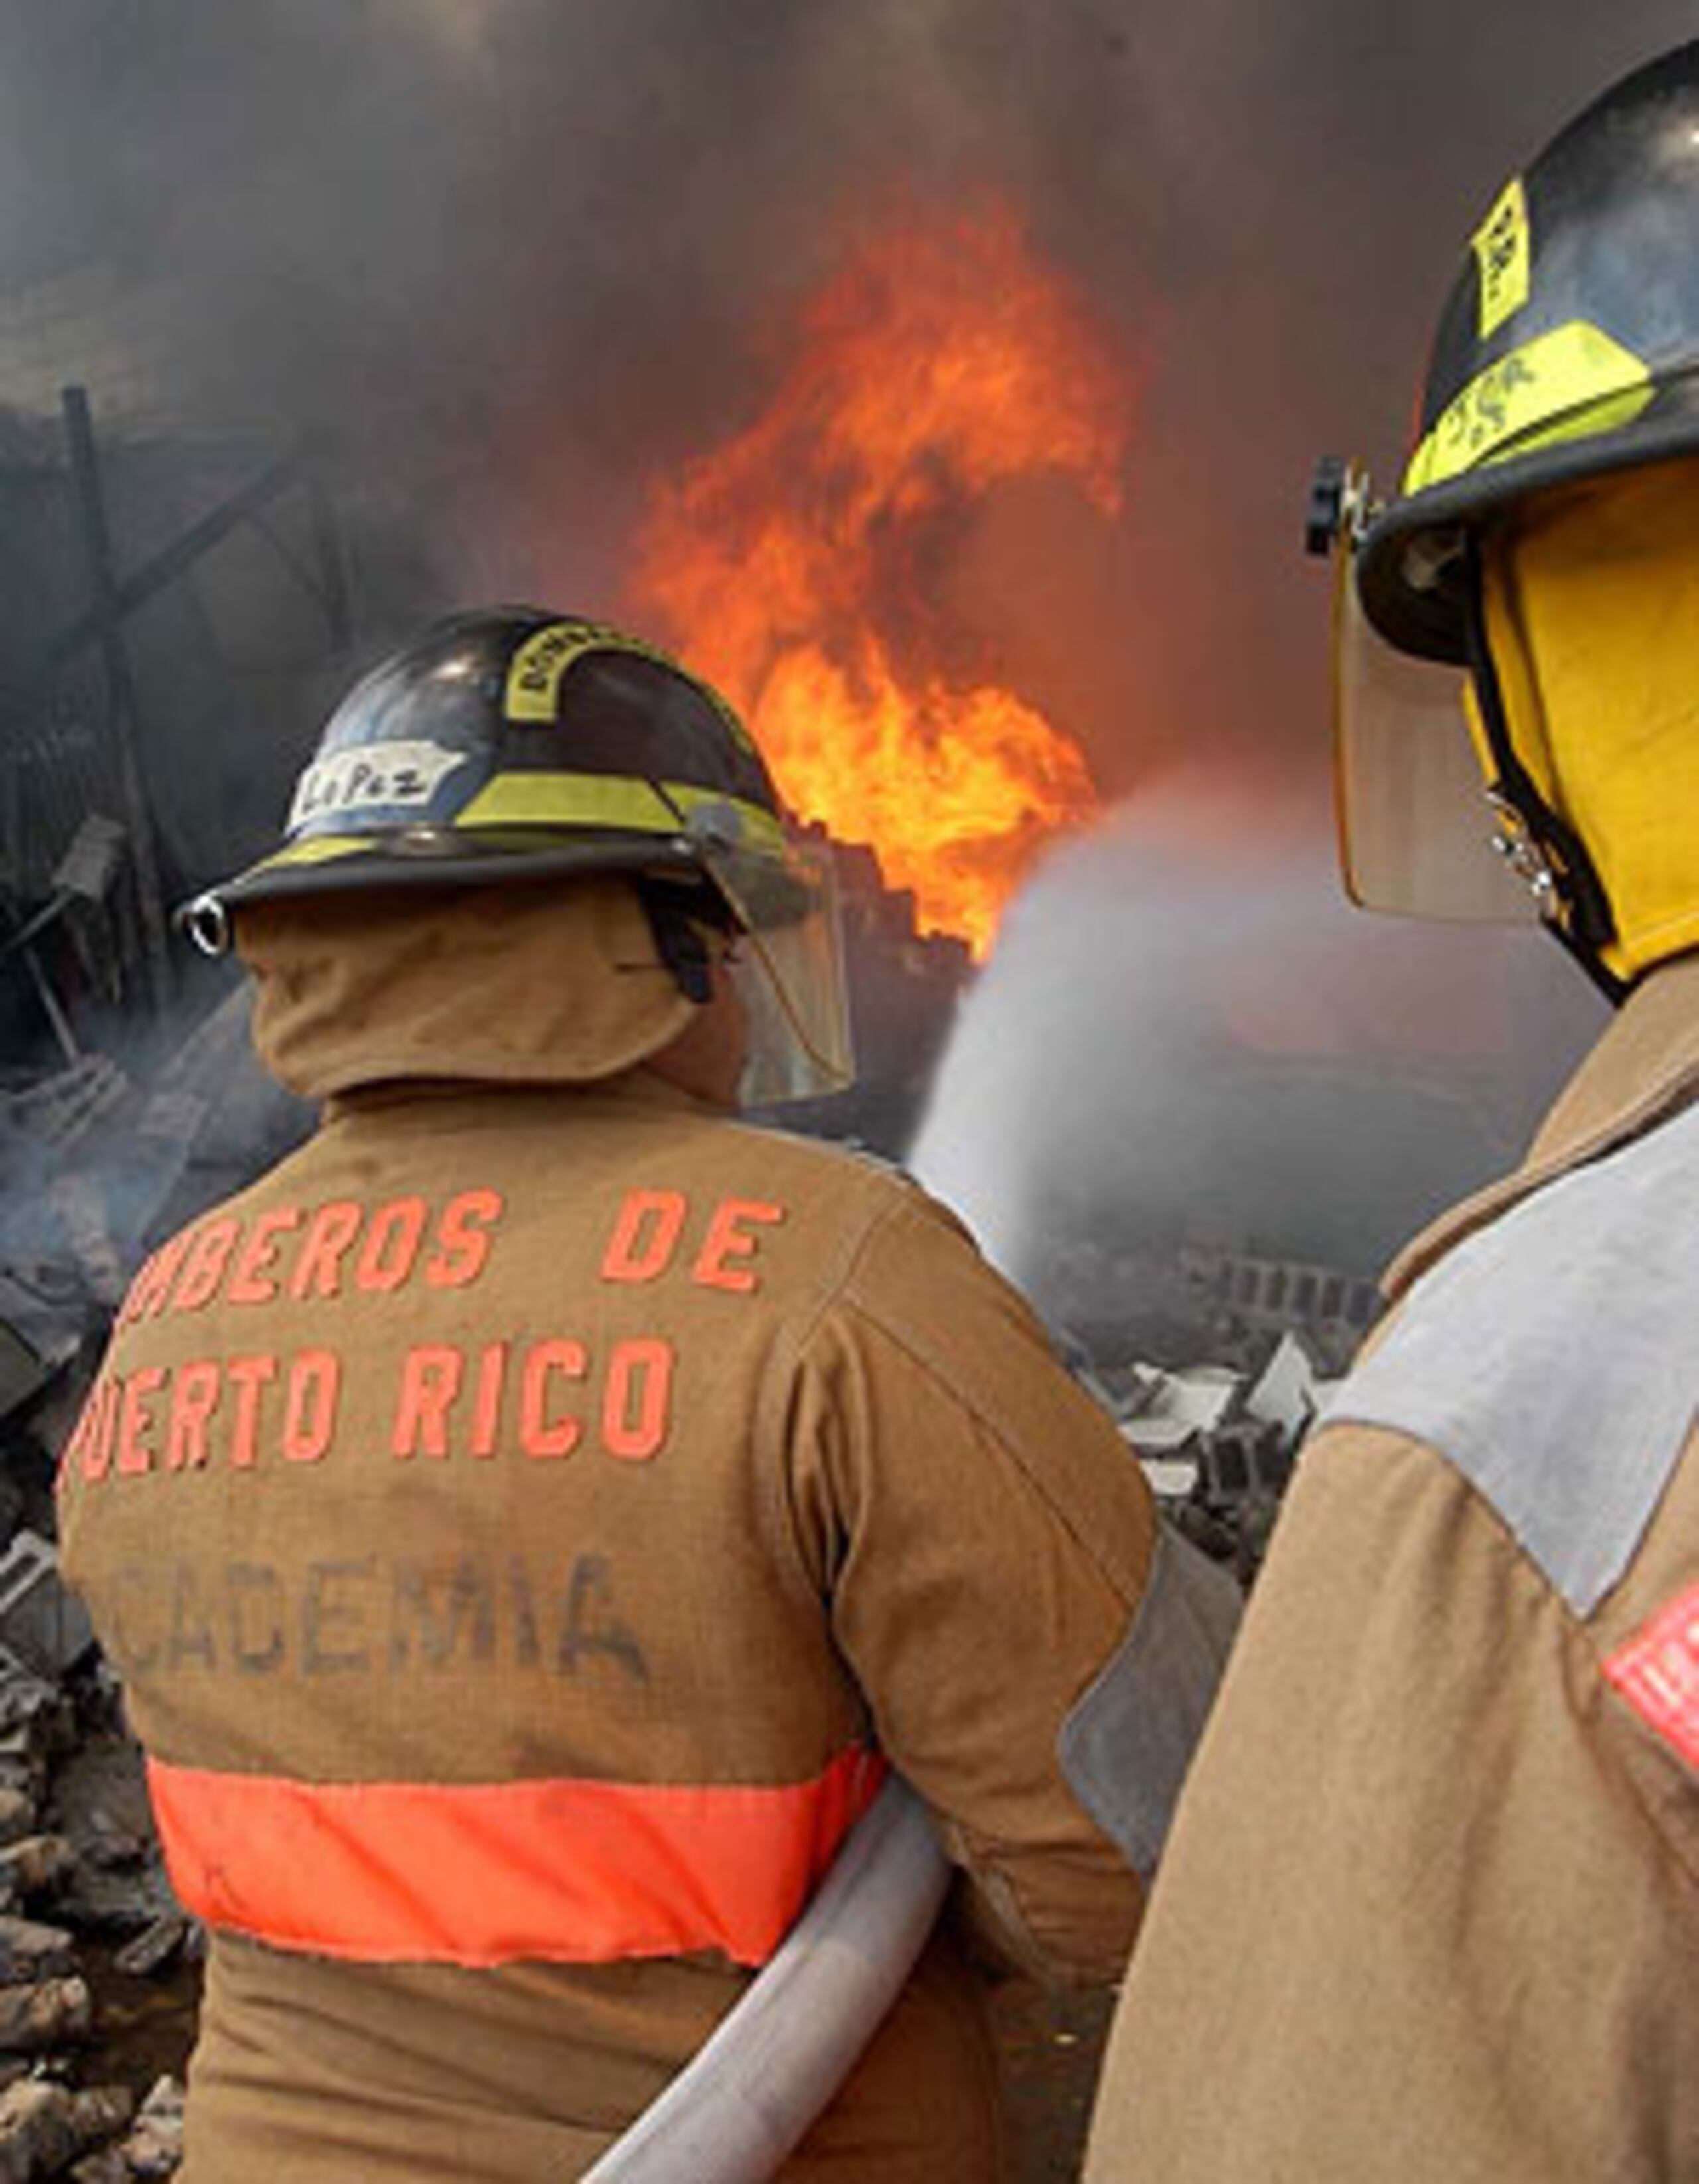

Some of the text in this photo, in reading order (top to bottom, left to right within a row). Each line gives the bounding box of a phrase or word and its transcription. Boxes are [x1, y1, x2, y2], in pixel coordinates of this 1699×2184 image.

[115, 1188, 784, 1325] MBEROS DE
[389, 1337, 674, 1460] RICO
